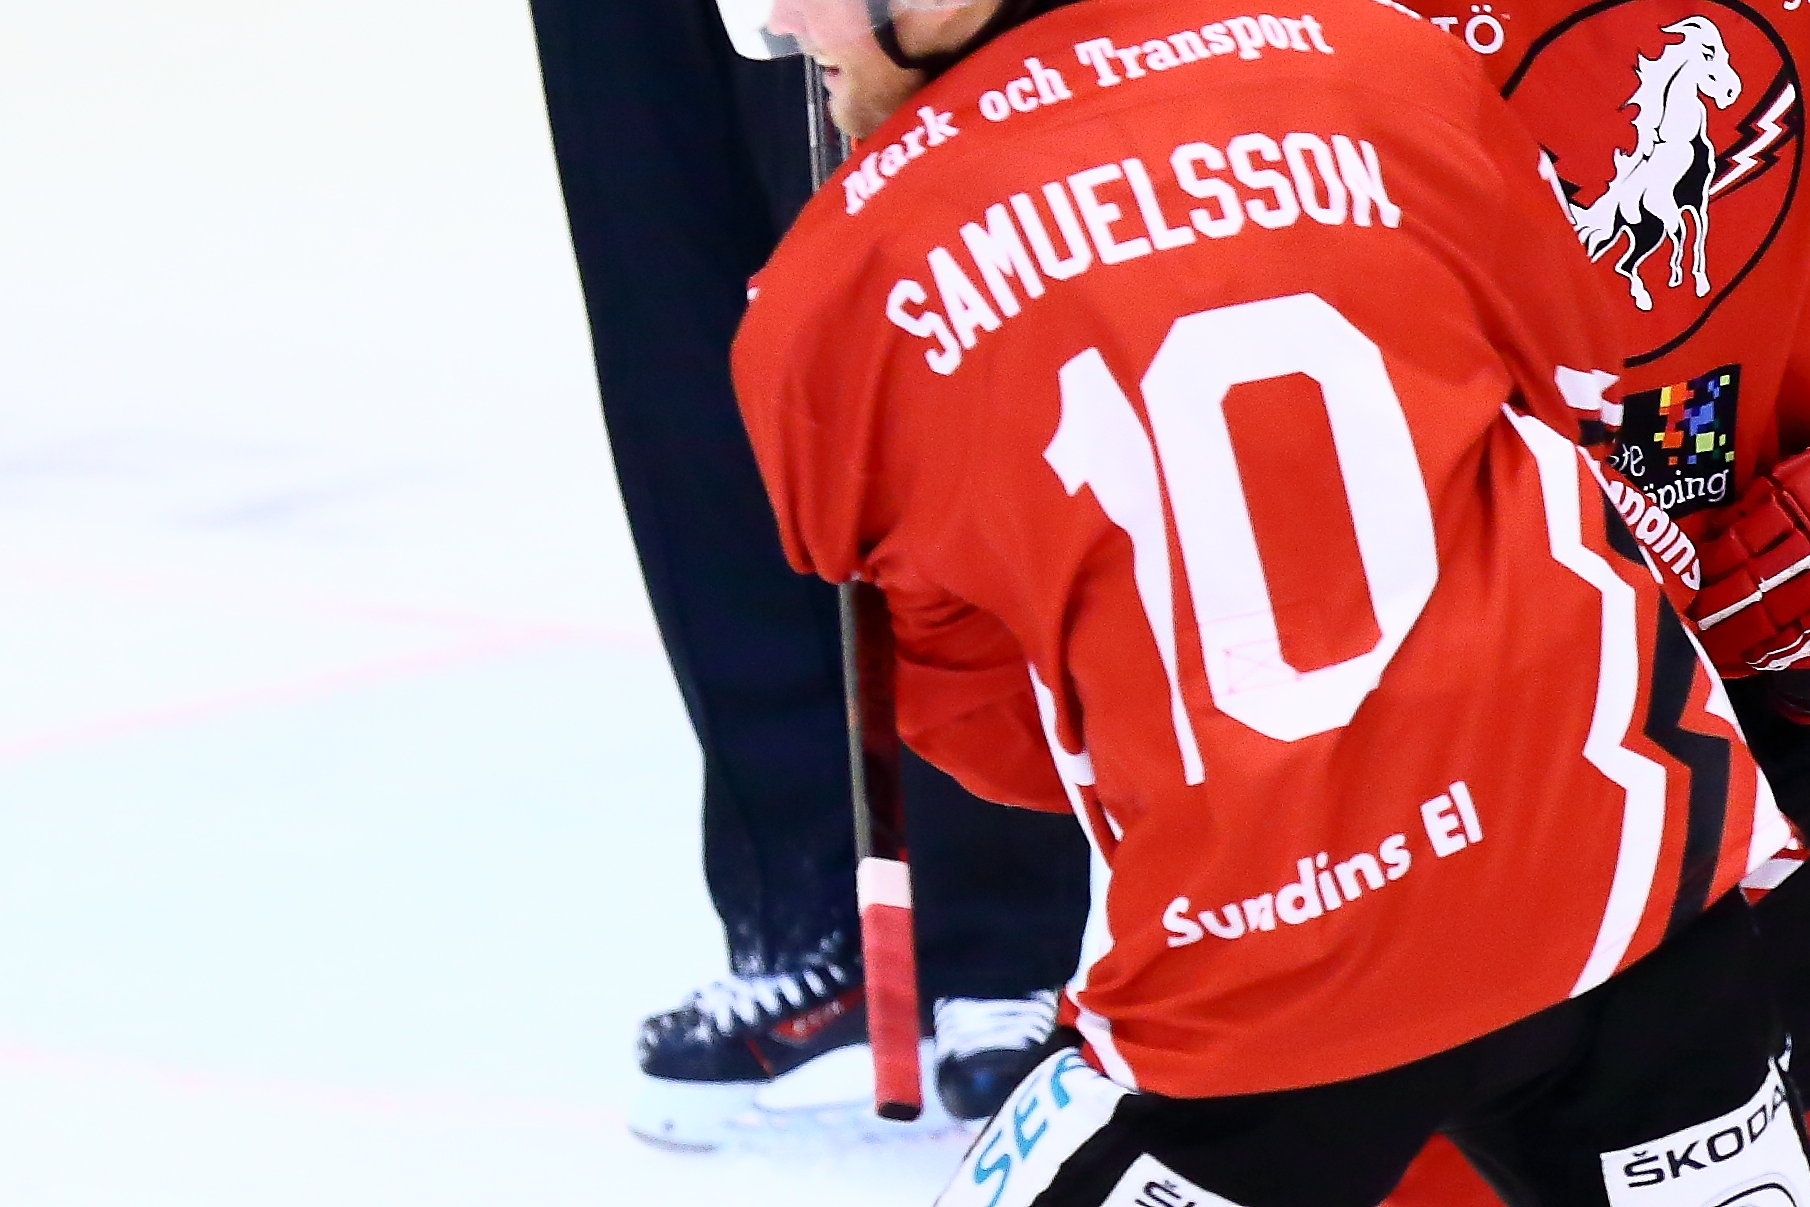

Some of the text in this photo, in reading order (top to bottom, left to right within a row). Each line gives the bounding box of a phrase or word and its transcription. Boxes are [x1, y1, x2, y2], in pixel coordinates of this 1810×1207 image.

[842, 12, 1334, 216] Mark och Transport
[885, 131, 1403, 376] SAMUELSSON
[1042, 291, 1440, 787] 10
[1160, 780, 1484, 949] Sundins El
